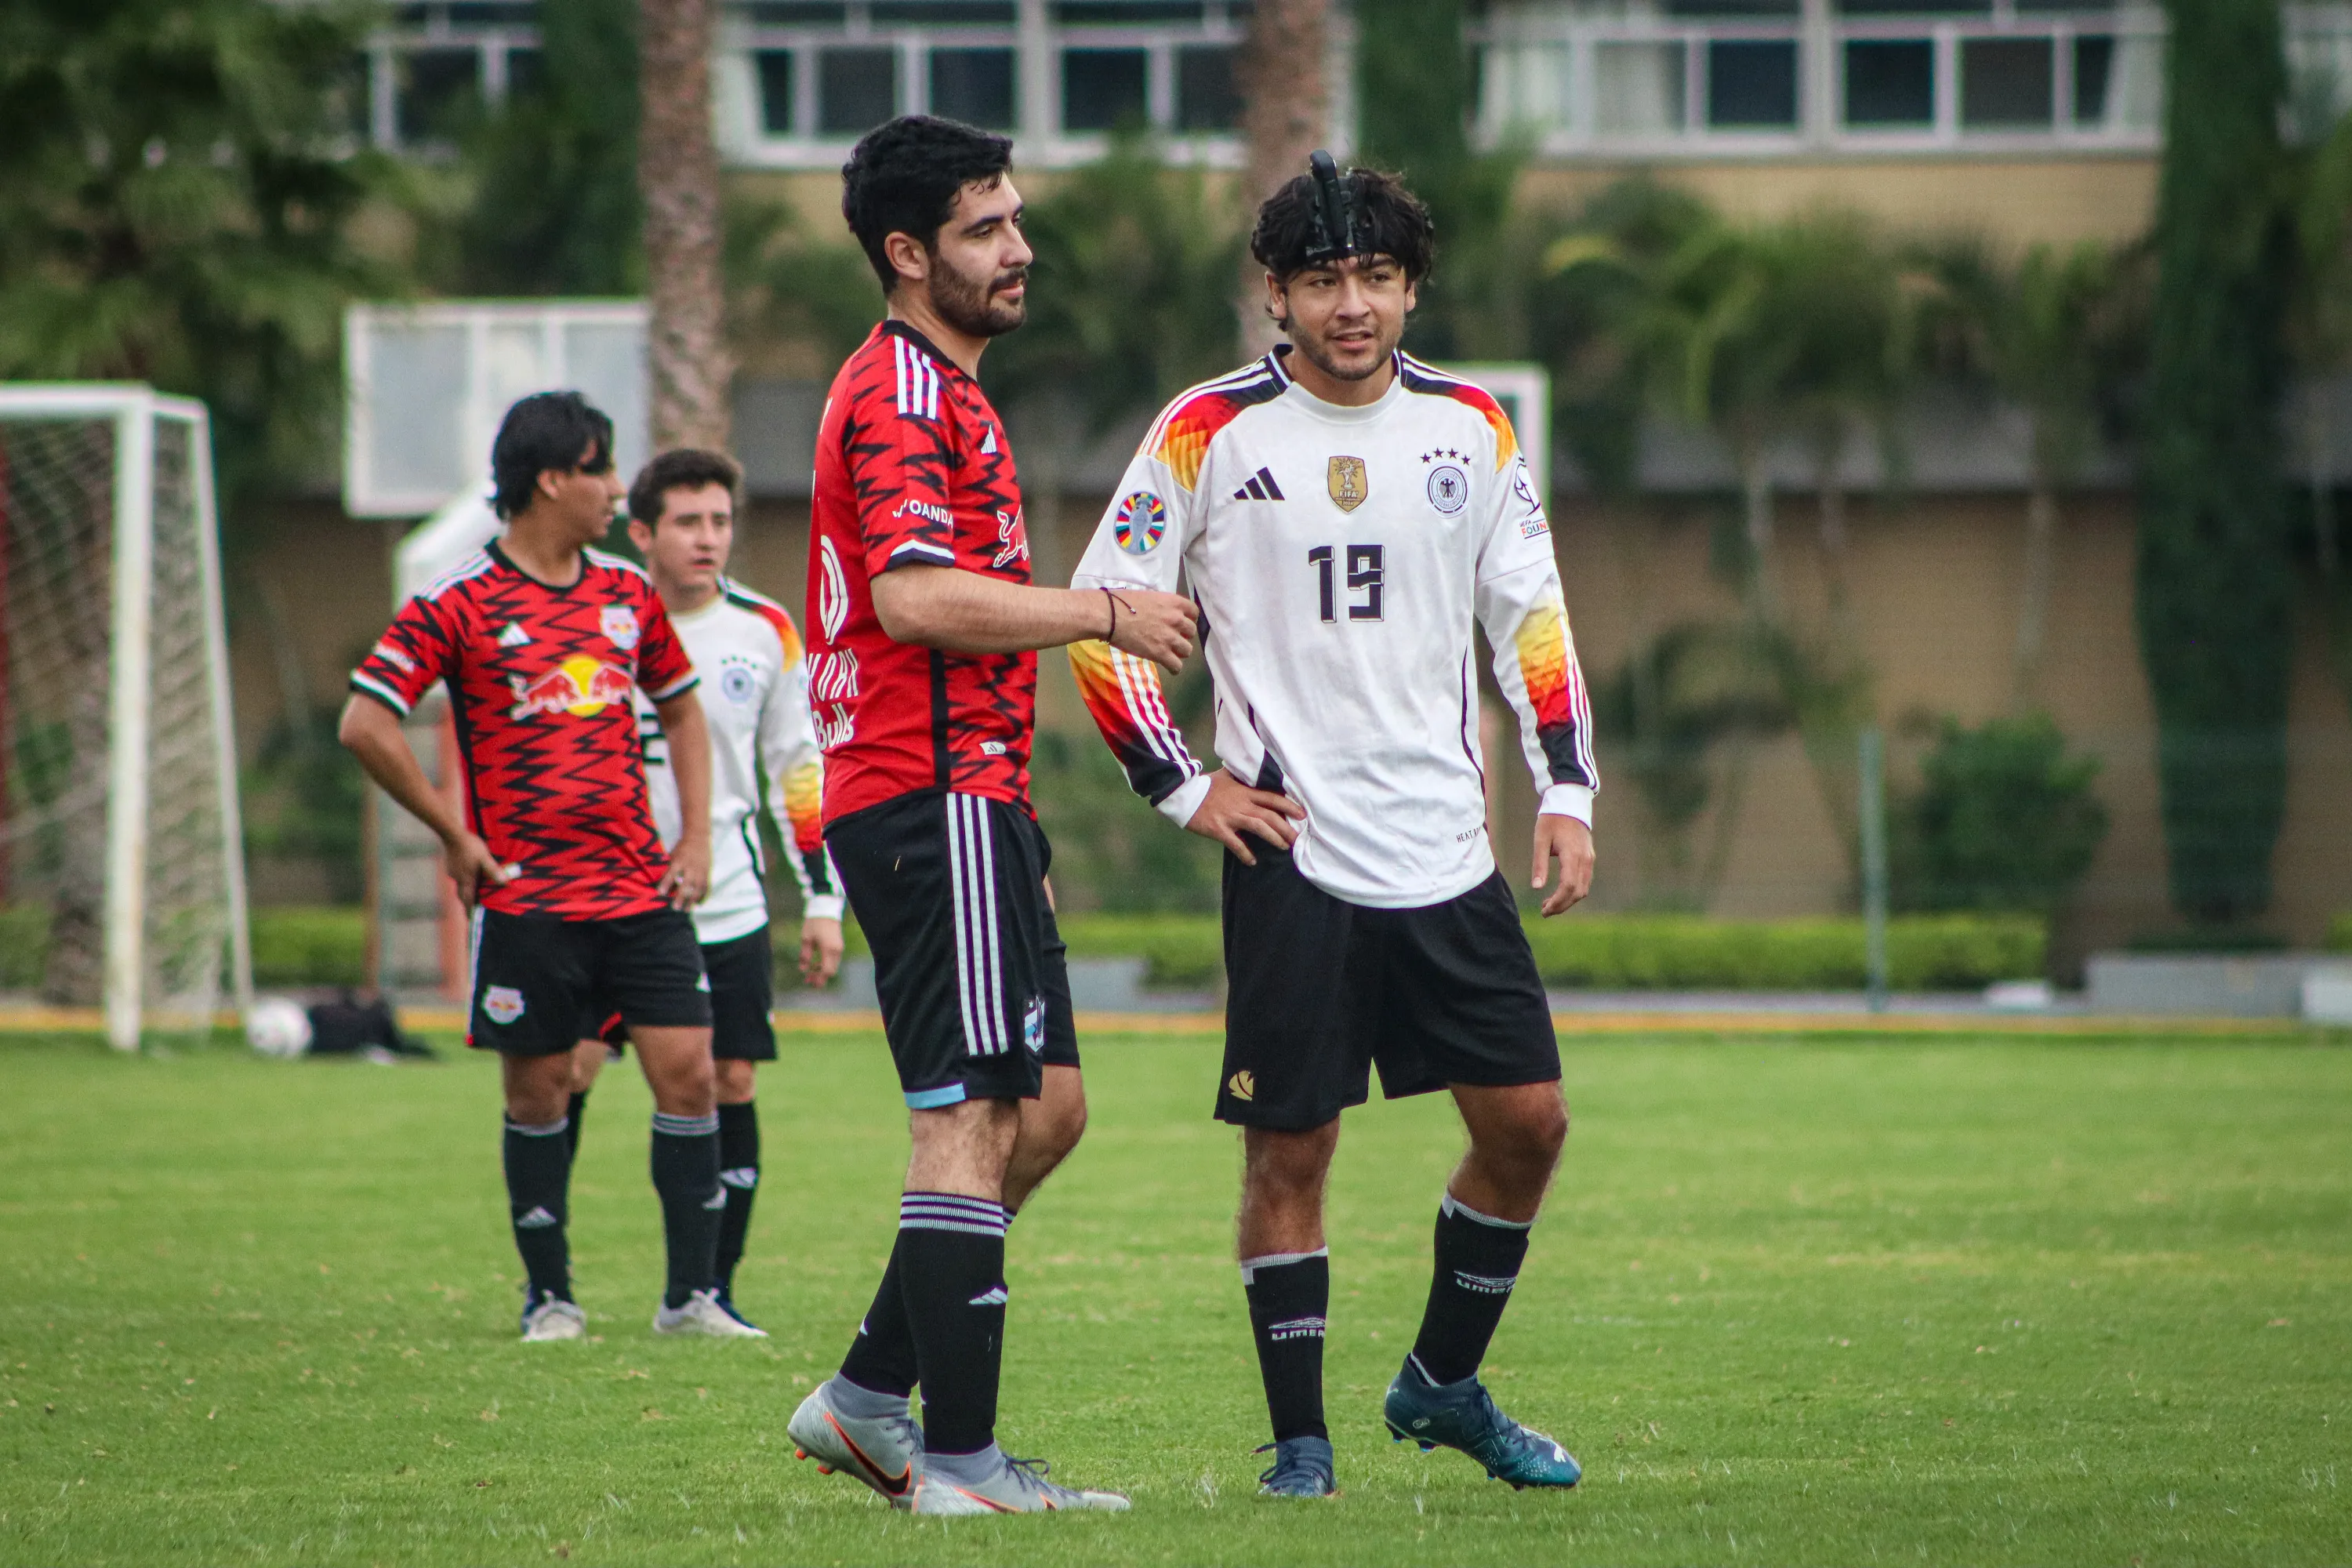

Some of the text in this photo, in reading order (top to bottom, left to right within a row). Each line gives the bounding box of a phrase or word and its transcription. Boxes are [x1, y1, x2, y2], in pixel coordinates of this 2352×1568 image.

[909, 499, 953, 529] OANDA
[1308, 544, 1385, 624] 19
[812, 702, 855, 751] Bulls
